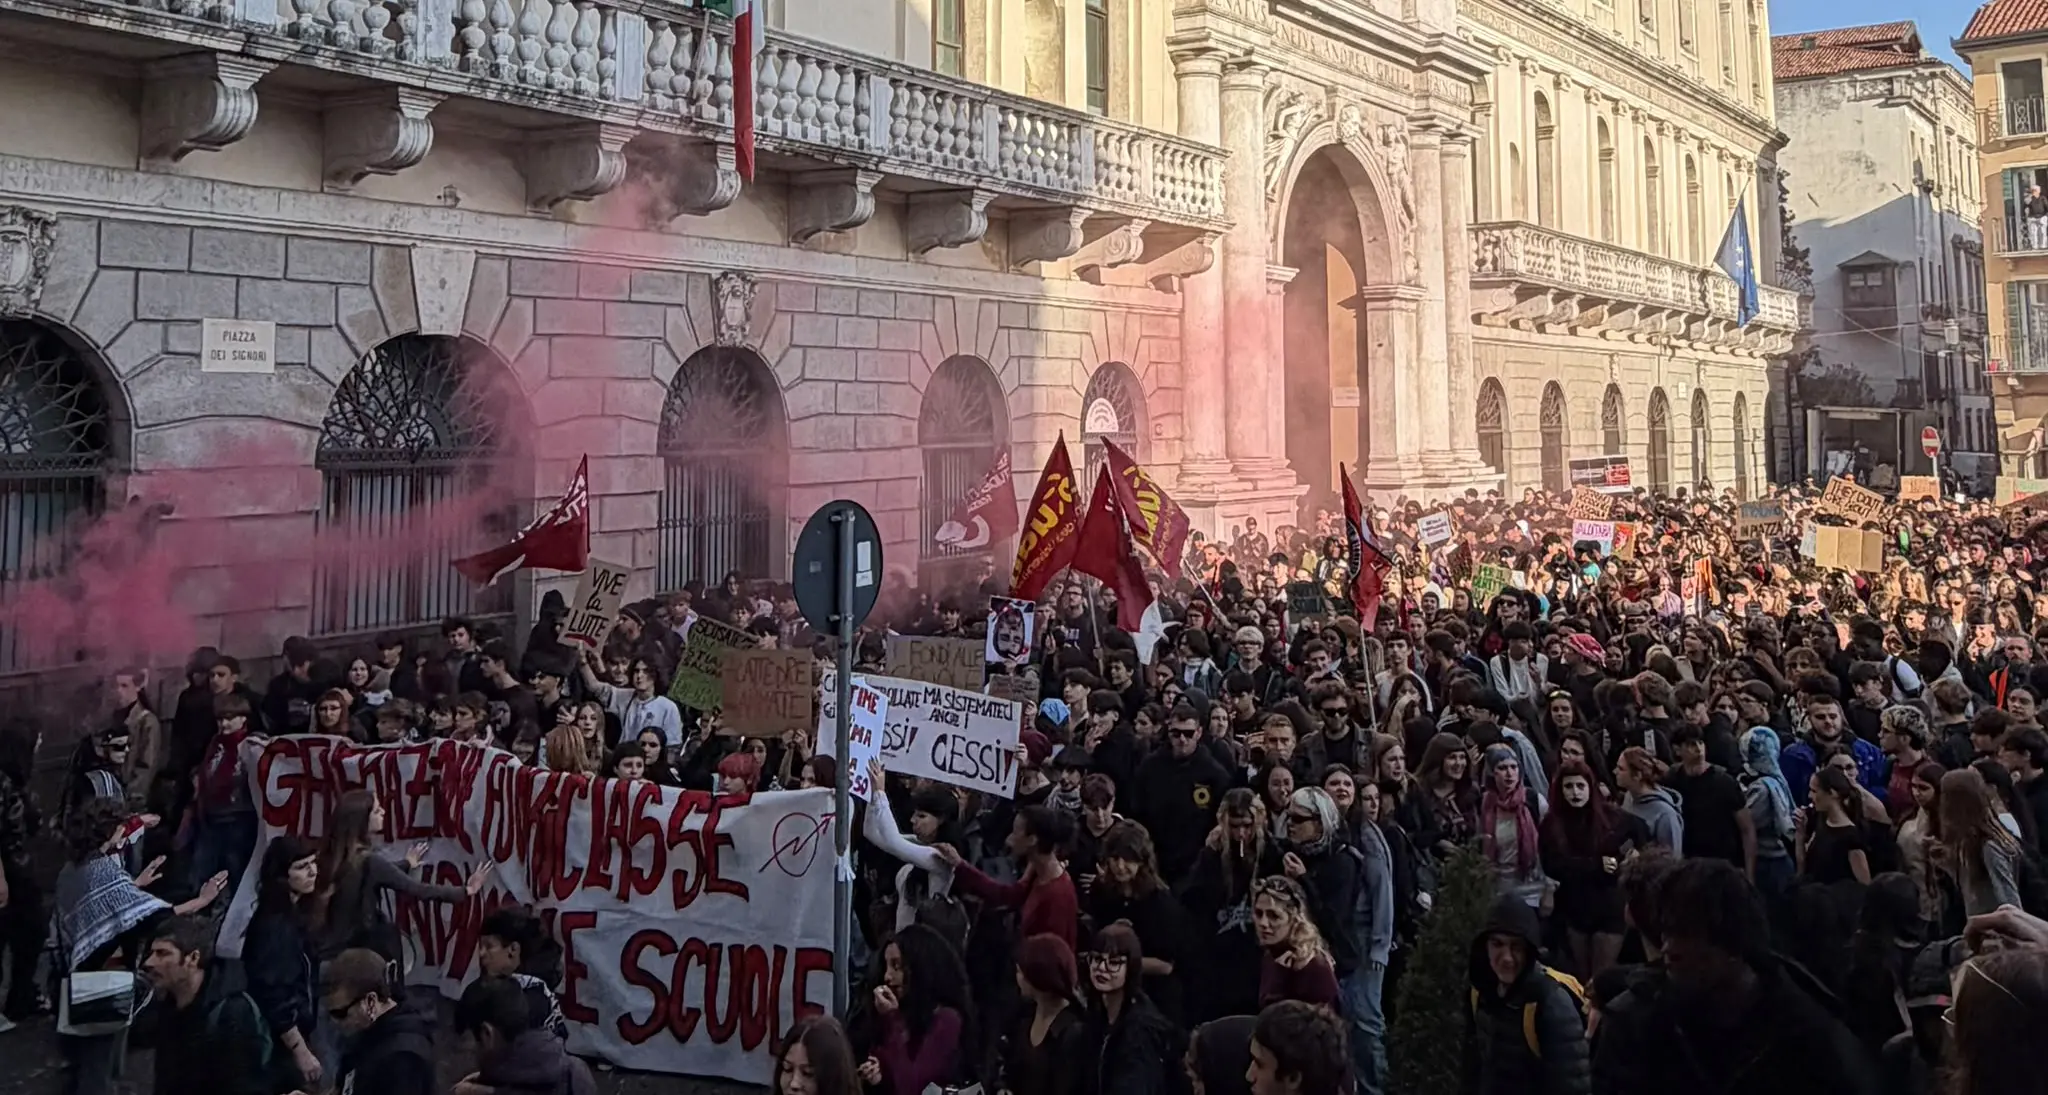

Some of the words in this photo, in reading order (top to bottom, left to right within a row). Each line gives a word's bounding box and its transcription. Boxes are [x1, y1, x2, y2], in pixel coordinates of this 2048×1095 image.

[222, 330, 257, 342] PIAZZA
[210, 349, 227, 361] DEI
[231, 350, 267, 362] SIGNORI
[592, 566, 627, 596] VIVE
[567, 609, 610, 637] LUTTE
[923, 686, 942, 707] MA
[615, 928, 834, 1057] SCUOLE
